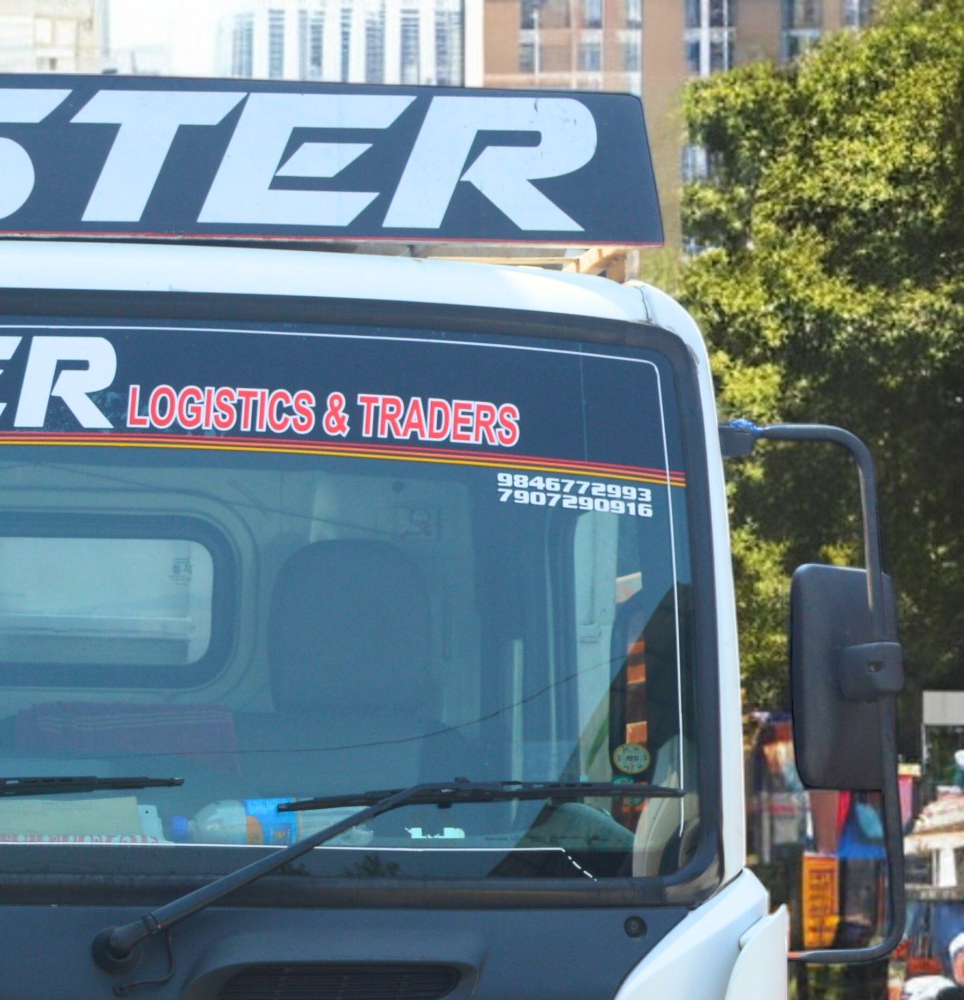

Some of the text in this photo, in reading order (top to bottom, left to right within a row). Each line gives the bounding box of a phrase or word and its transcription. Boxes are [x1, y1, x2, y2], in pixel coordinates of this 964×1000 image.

[127, 384, 316, 433] LOGISTICS
[322, 391, 350, 438] &
[357, 393, 520, 447] TRADERS
[497, 472, 652, 502] 9846772993
[497, 488, 654, 518] 7907290916
